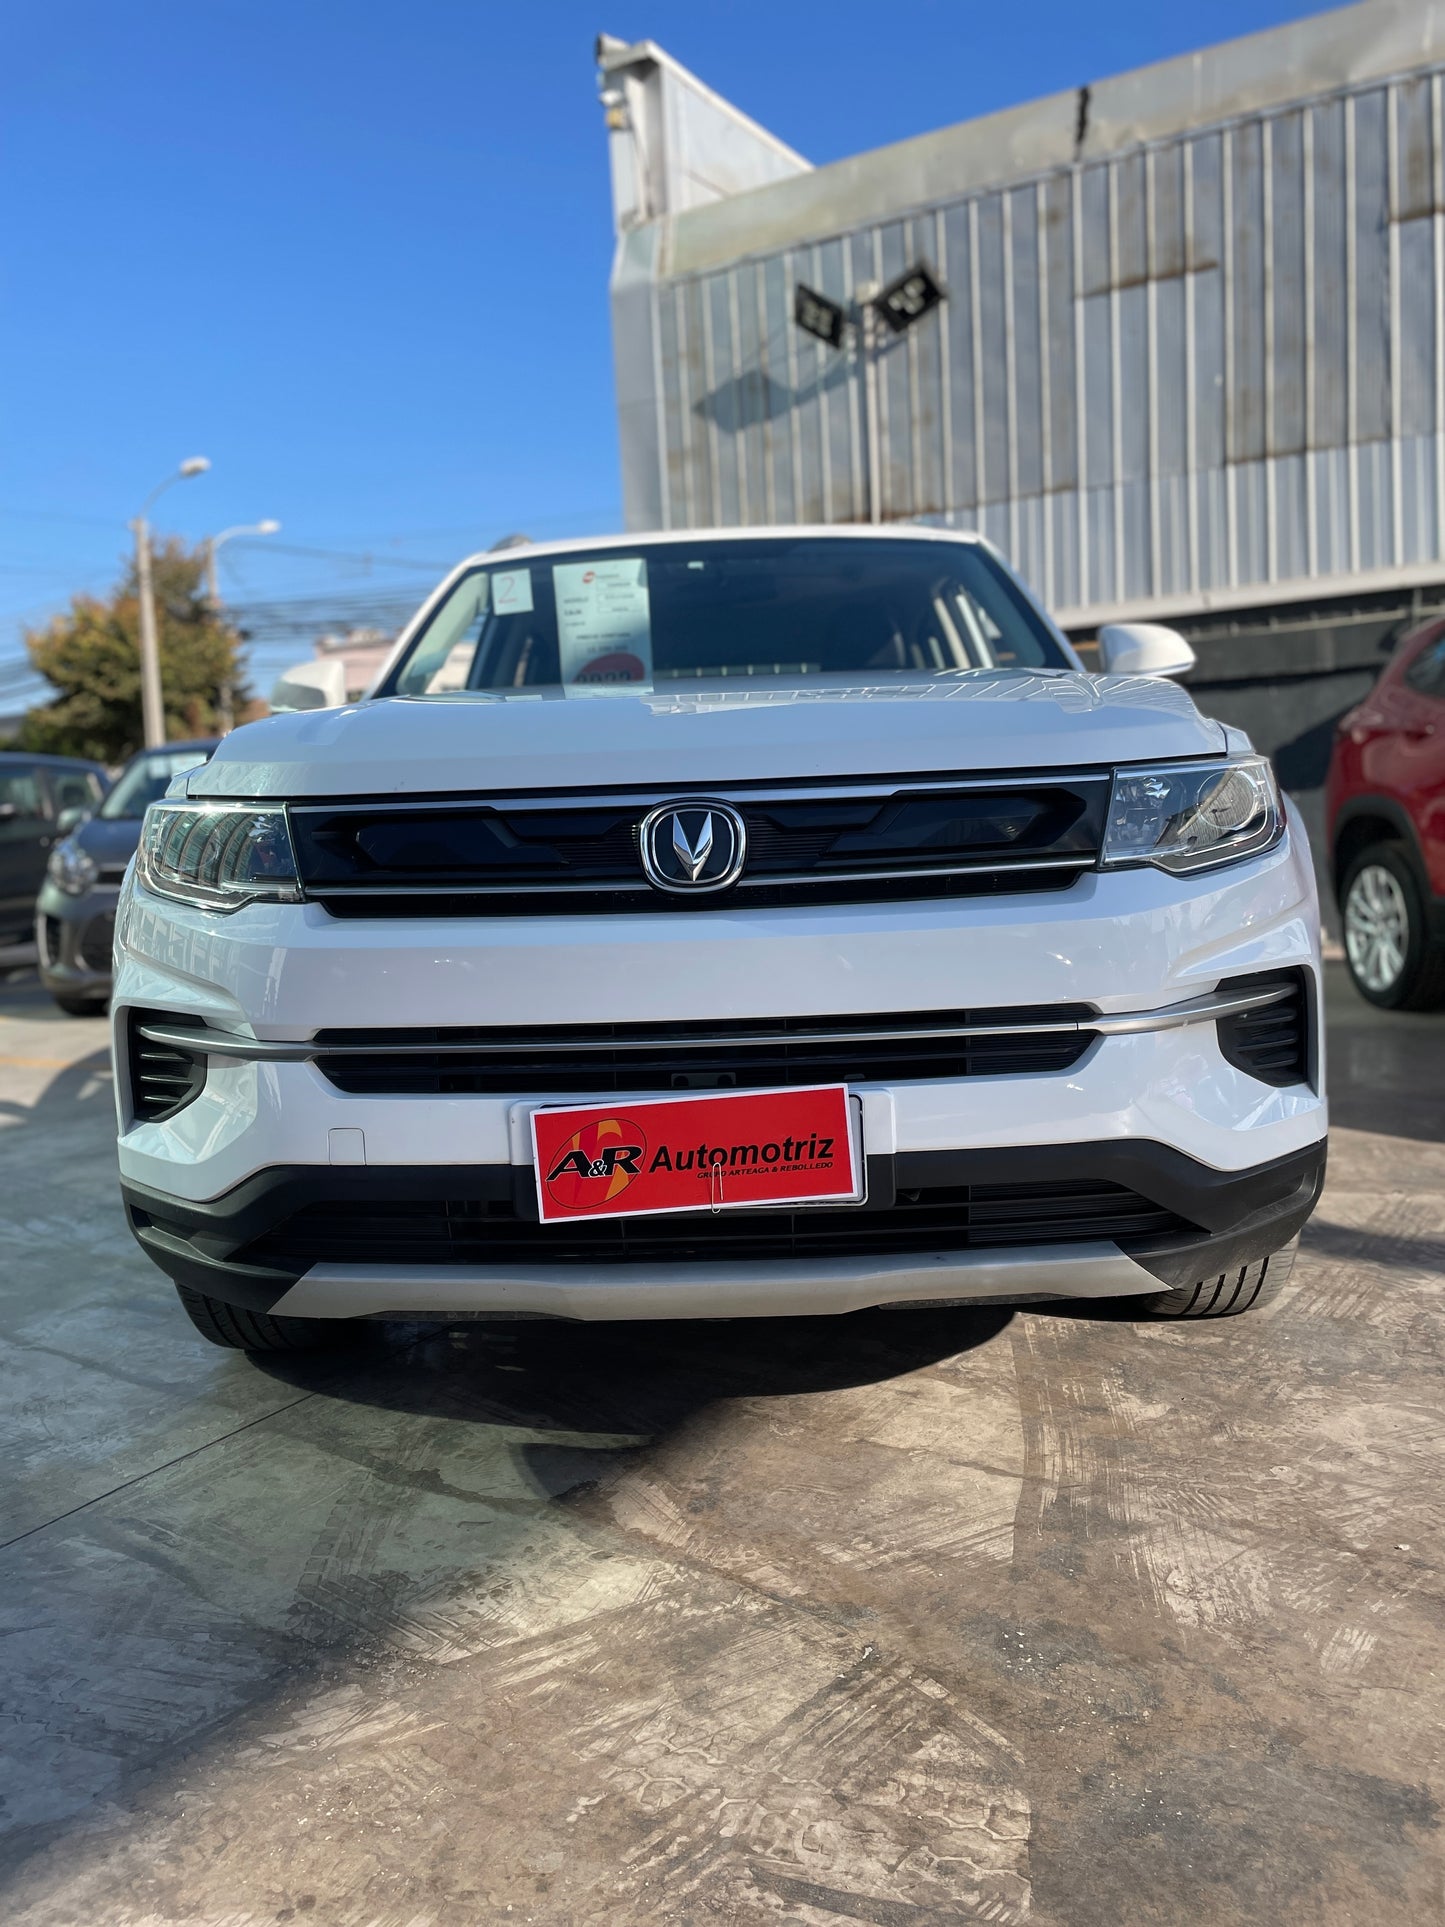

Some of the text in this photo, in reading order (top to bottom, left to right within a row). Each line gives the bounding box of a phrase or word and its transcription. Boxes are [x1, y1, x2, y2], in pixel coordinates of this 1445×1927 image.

[498, 576, 517, 604] 2
[545, 1133, 834, 1182] A&R Automotriz
[729, 1167, 769, 1176] ARTEAGA
[780, 1161, 833, 1172] REBOLLEDO
